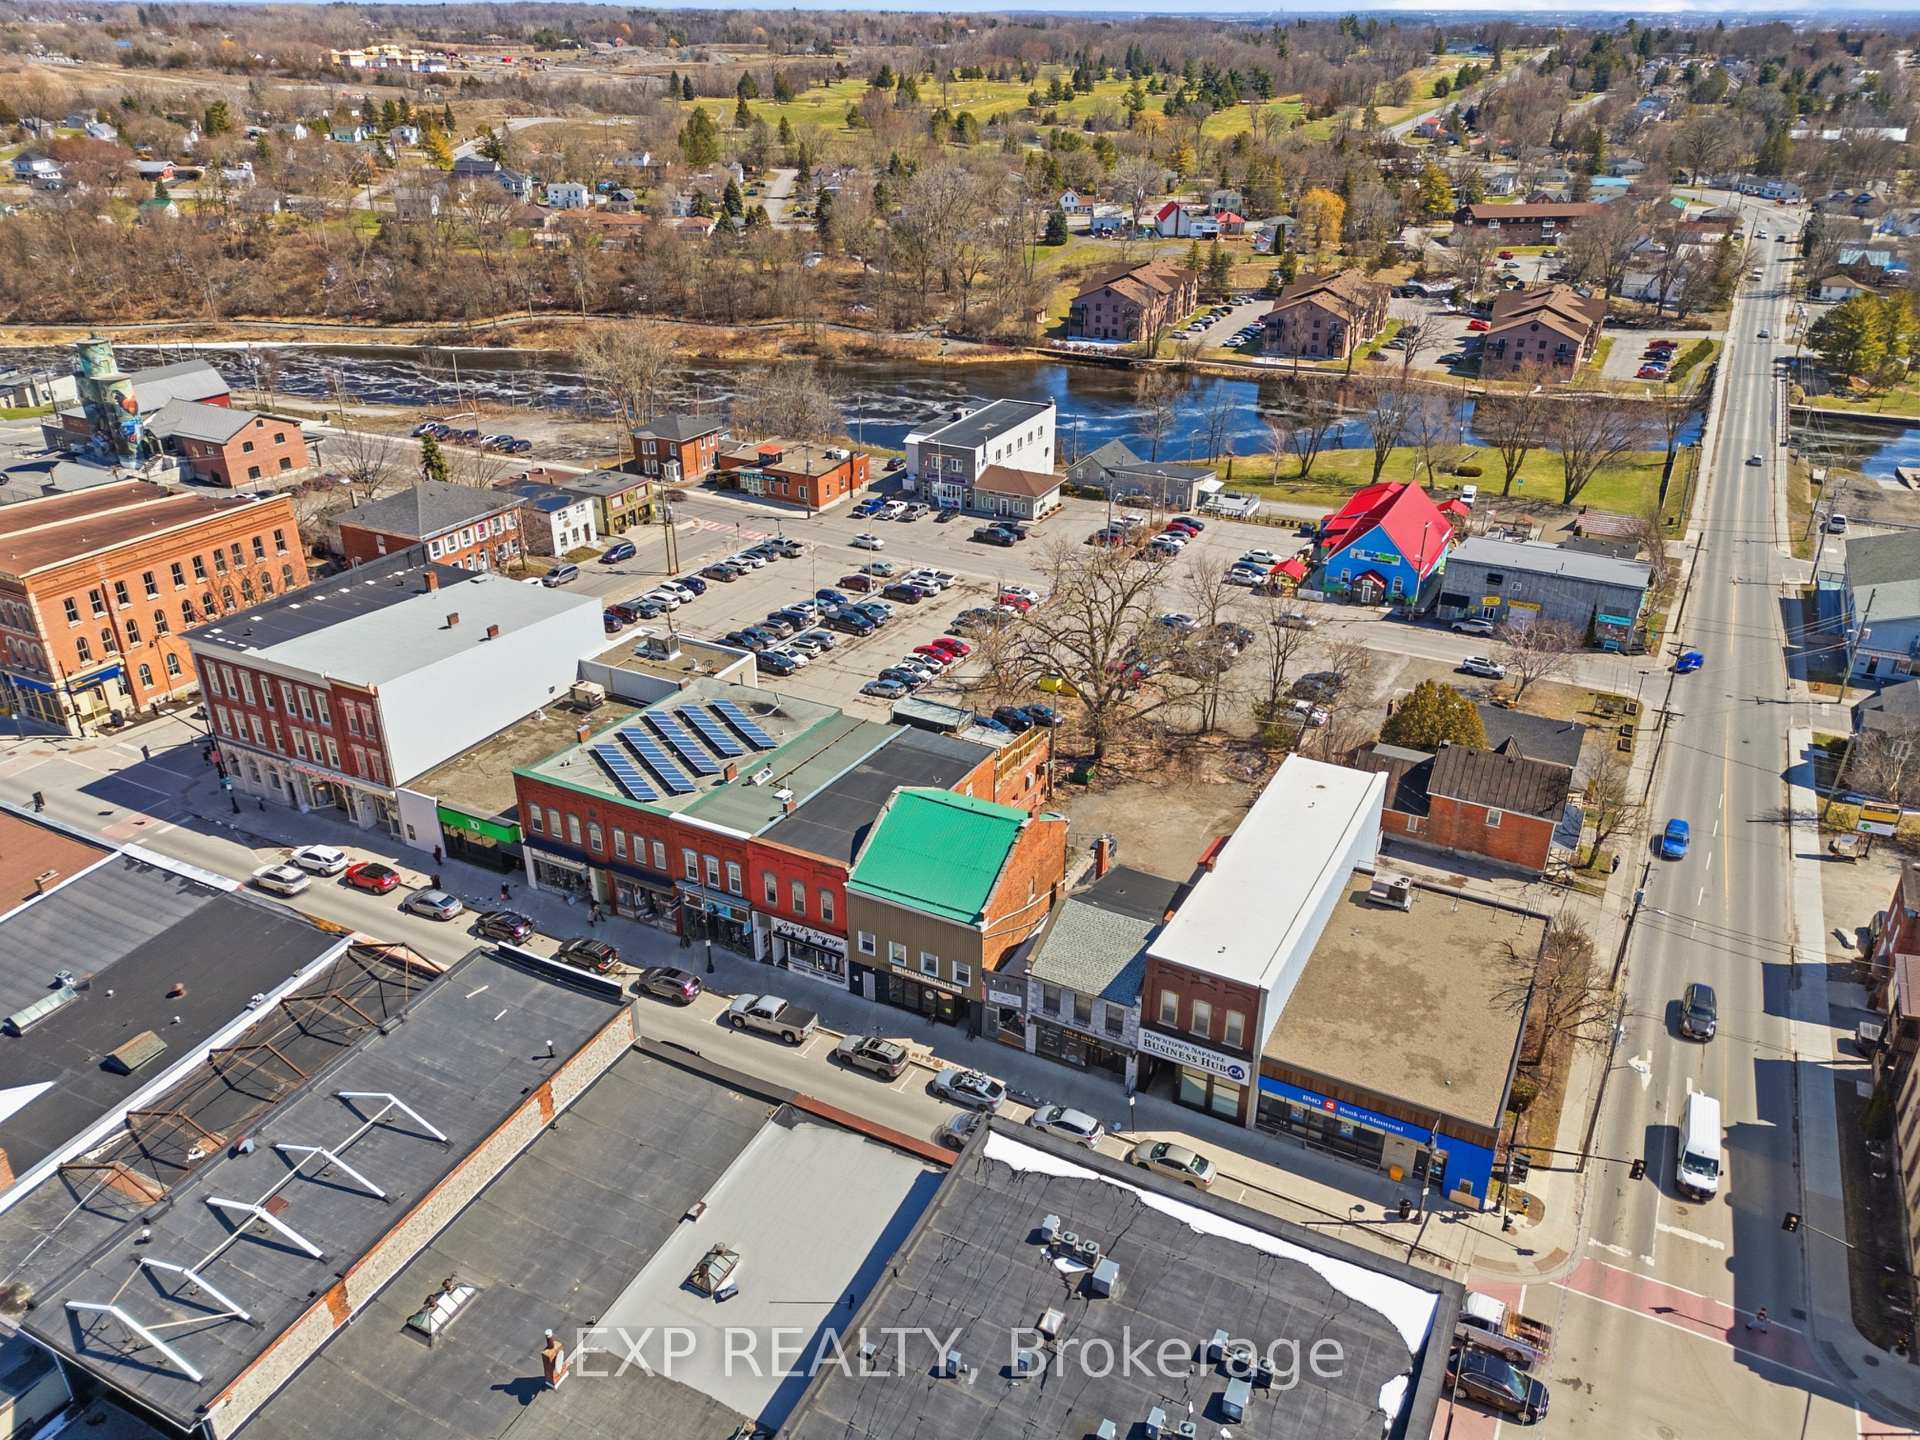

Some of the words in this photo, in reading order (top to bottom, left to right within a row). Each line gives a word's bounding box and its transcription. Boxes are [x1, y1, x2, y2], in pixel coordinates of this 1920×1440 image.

[1143, 1039, 1198, 1063] BUSINESS
[1200, 1057, 1228, 1073] HUB
[1302, 1094, 1321, 1105] BMO
[1339, 1107, 1359, 1117] Bank
[1359, 1113, 1368, 1121] of
[1368, 1115, 1404, 1132] Montreal
